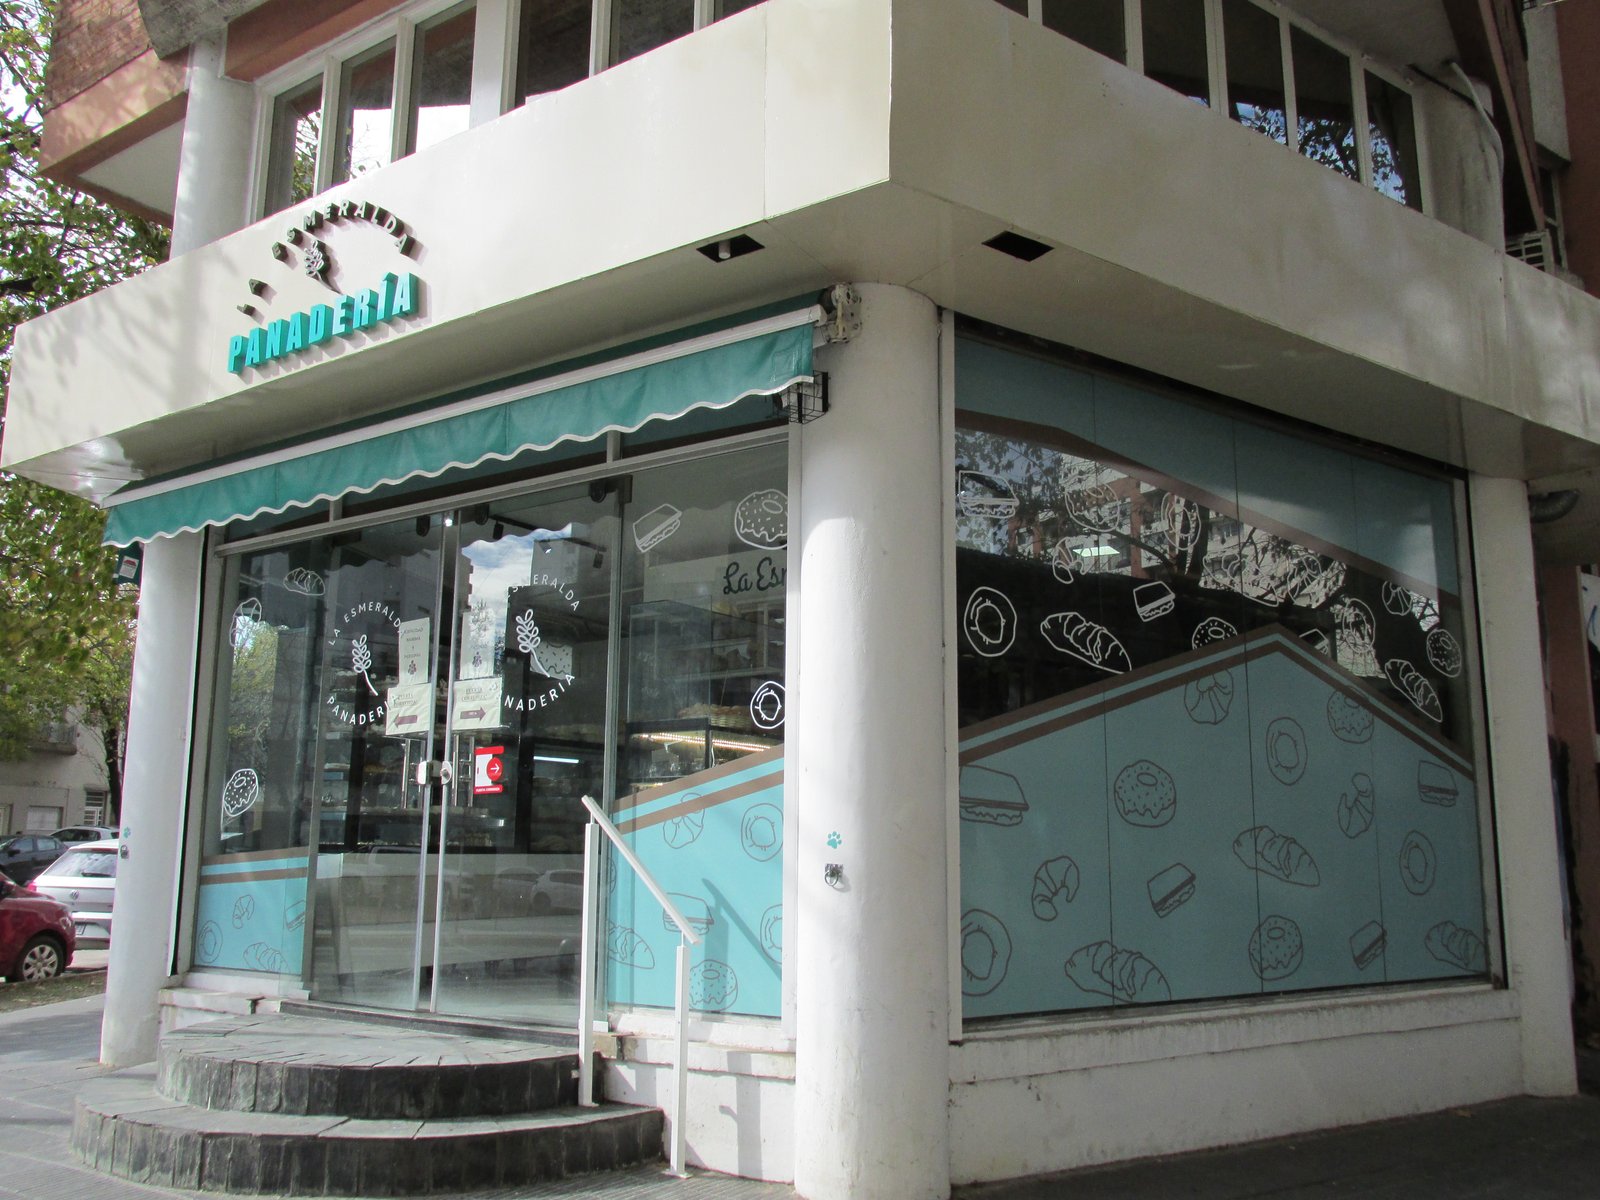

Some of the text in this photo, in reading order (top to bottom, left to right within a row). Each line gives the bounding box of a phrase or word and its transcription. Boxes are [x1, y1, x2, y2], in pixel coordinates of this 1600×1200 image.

[272, 200, 416, 261] ESMERALDA
[723, 561, 753, 595] La
[328, 601, 403, 646] LA ESMERALD
[326, 695, 394, 726] PANADERI
